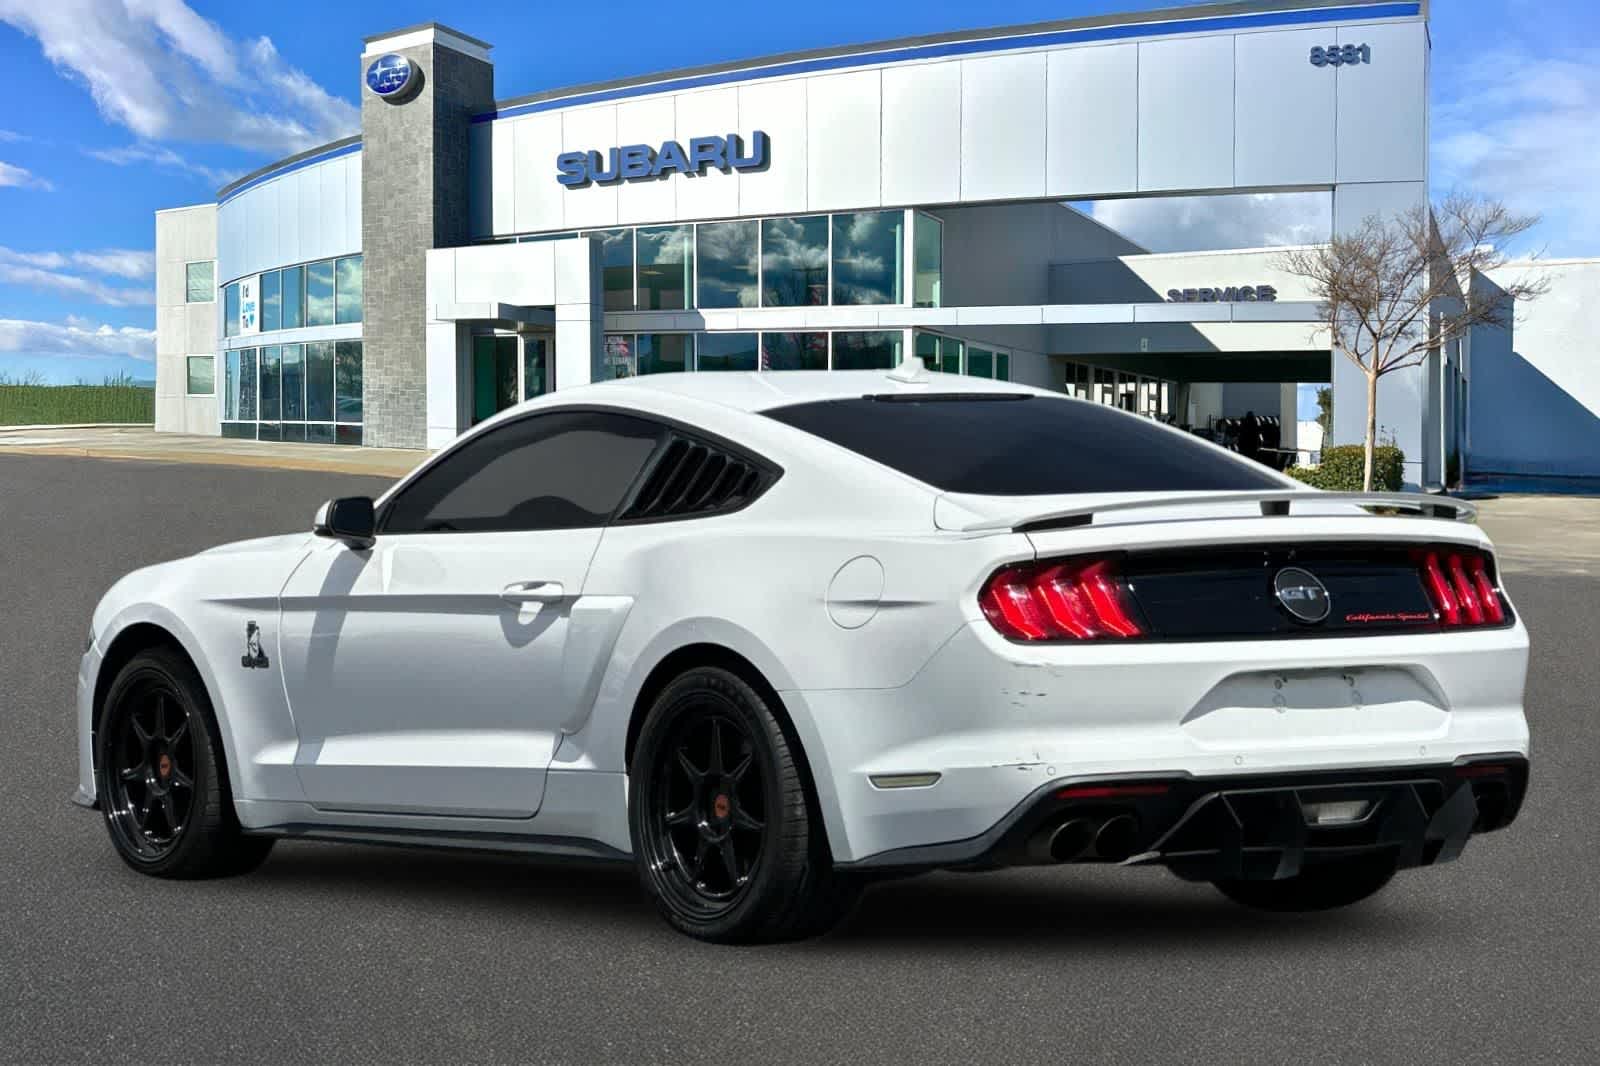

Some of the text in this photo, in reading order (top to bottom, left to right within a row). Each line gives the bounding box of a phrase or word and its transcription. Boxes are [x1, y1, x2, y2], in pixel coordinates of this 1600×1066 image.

[556, 130, 770, 190] SUBARU
[1167, 285, 1277, 303] SERVICE
[1280, 586, 1321, 600] GT
